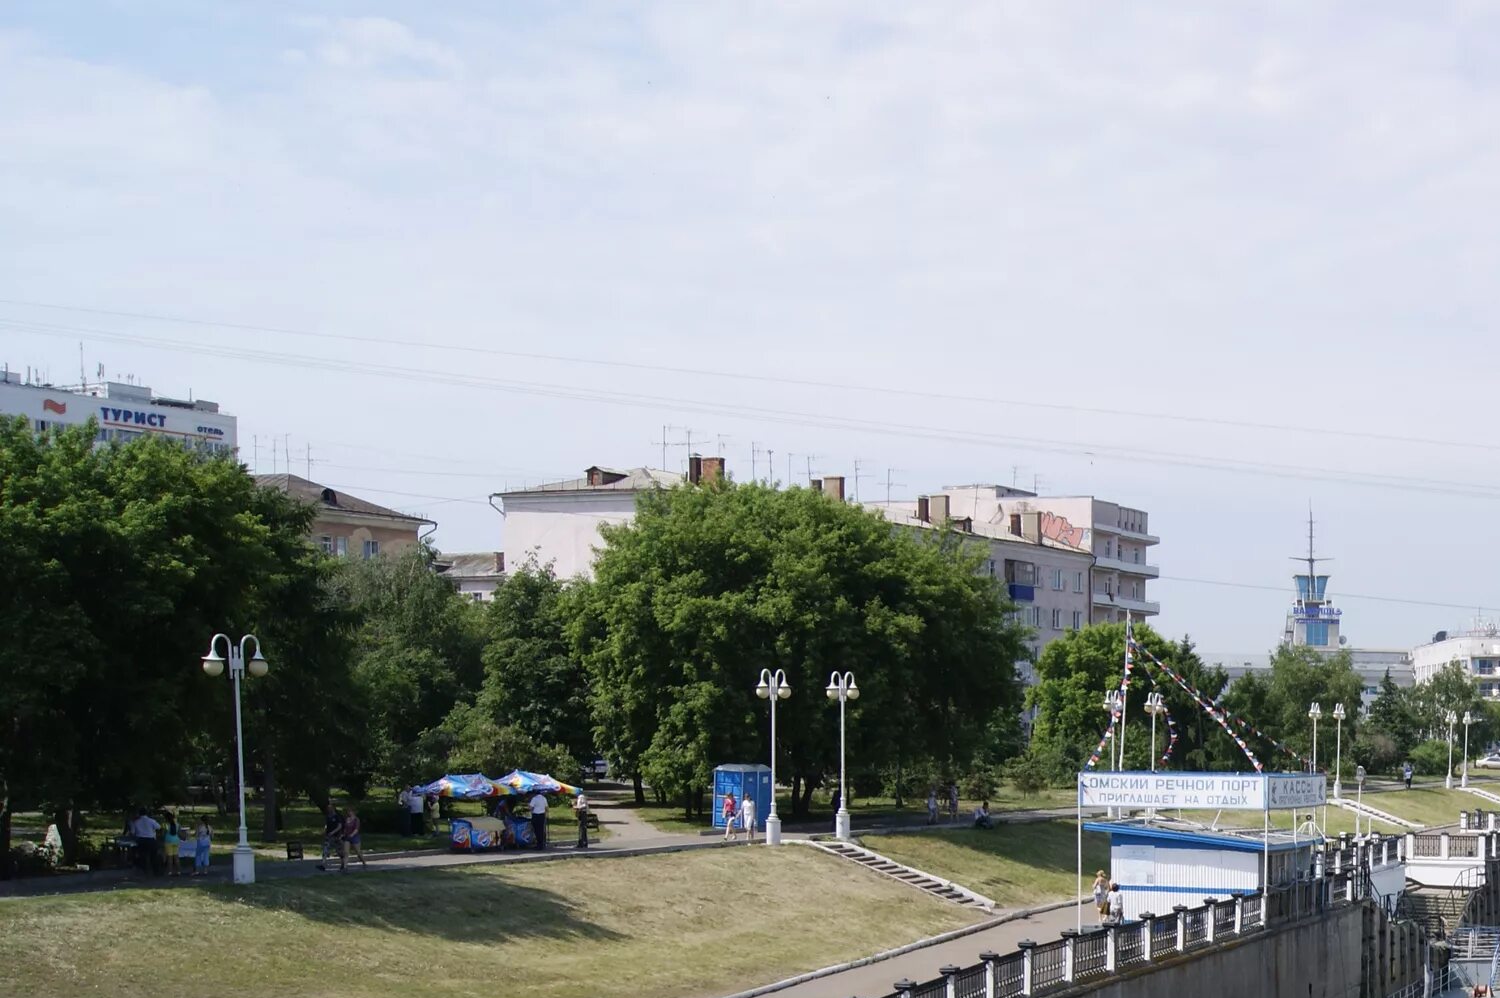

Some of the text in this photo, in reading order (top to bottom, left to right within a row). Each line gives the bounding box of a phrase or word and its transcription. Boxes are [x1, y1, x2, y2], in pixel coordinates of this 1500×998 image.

[100, 406, 167, 428] ТУРИСТ
[196, 425, 224, 436] отель
[1221, 780, 1259, 792] ПОРТ
[1283, 780, 1314, 794] КАССЫ
[1098, 793, 1248, 805] ПРИГЛАШАЕТ НА ОТДЫХ
